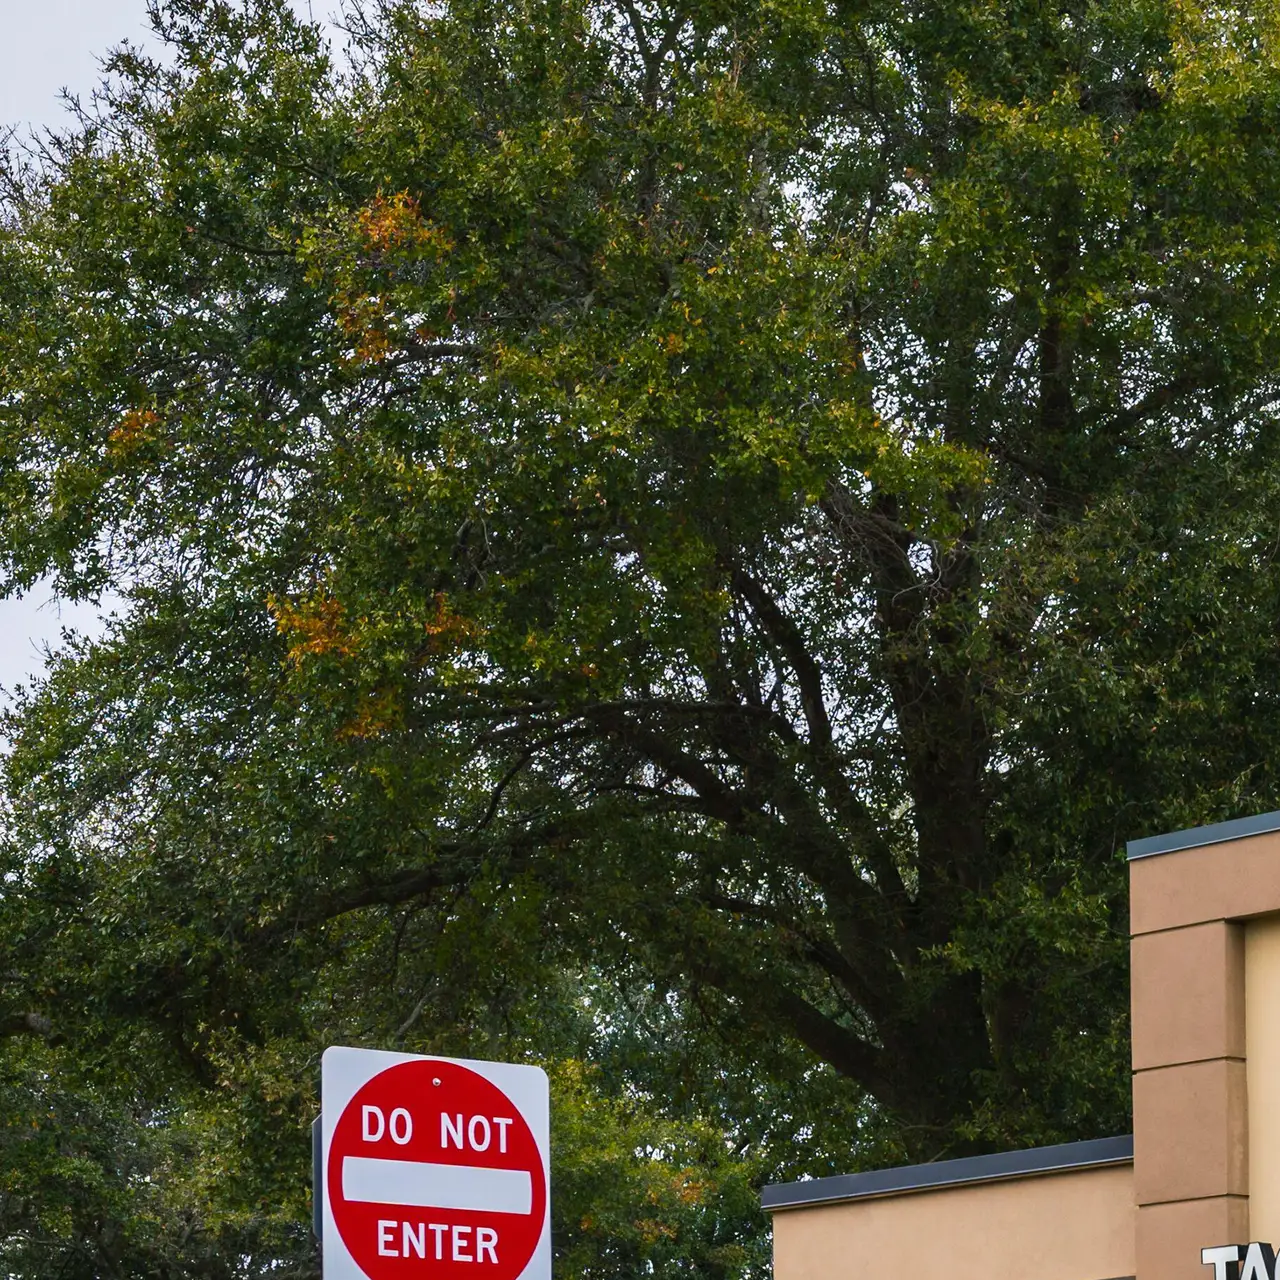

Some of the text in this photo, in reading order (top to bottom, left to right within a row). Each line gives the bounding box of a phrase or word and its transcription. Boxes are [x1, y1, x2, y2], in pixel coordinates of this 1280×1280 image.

[361, 1104, 513, 1154] DO NOT
[377, 1219, 499, 1264] ENTER
